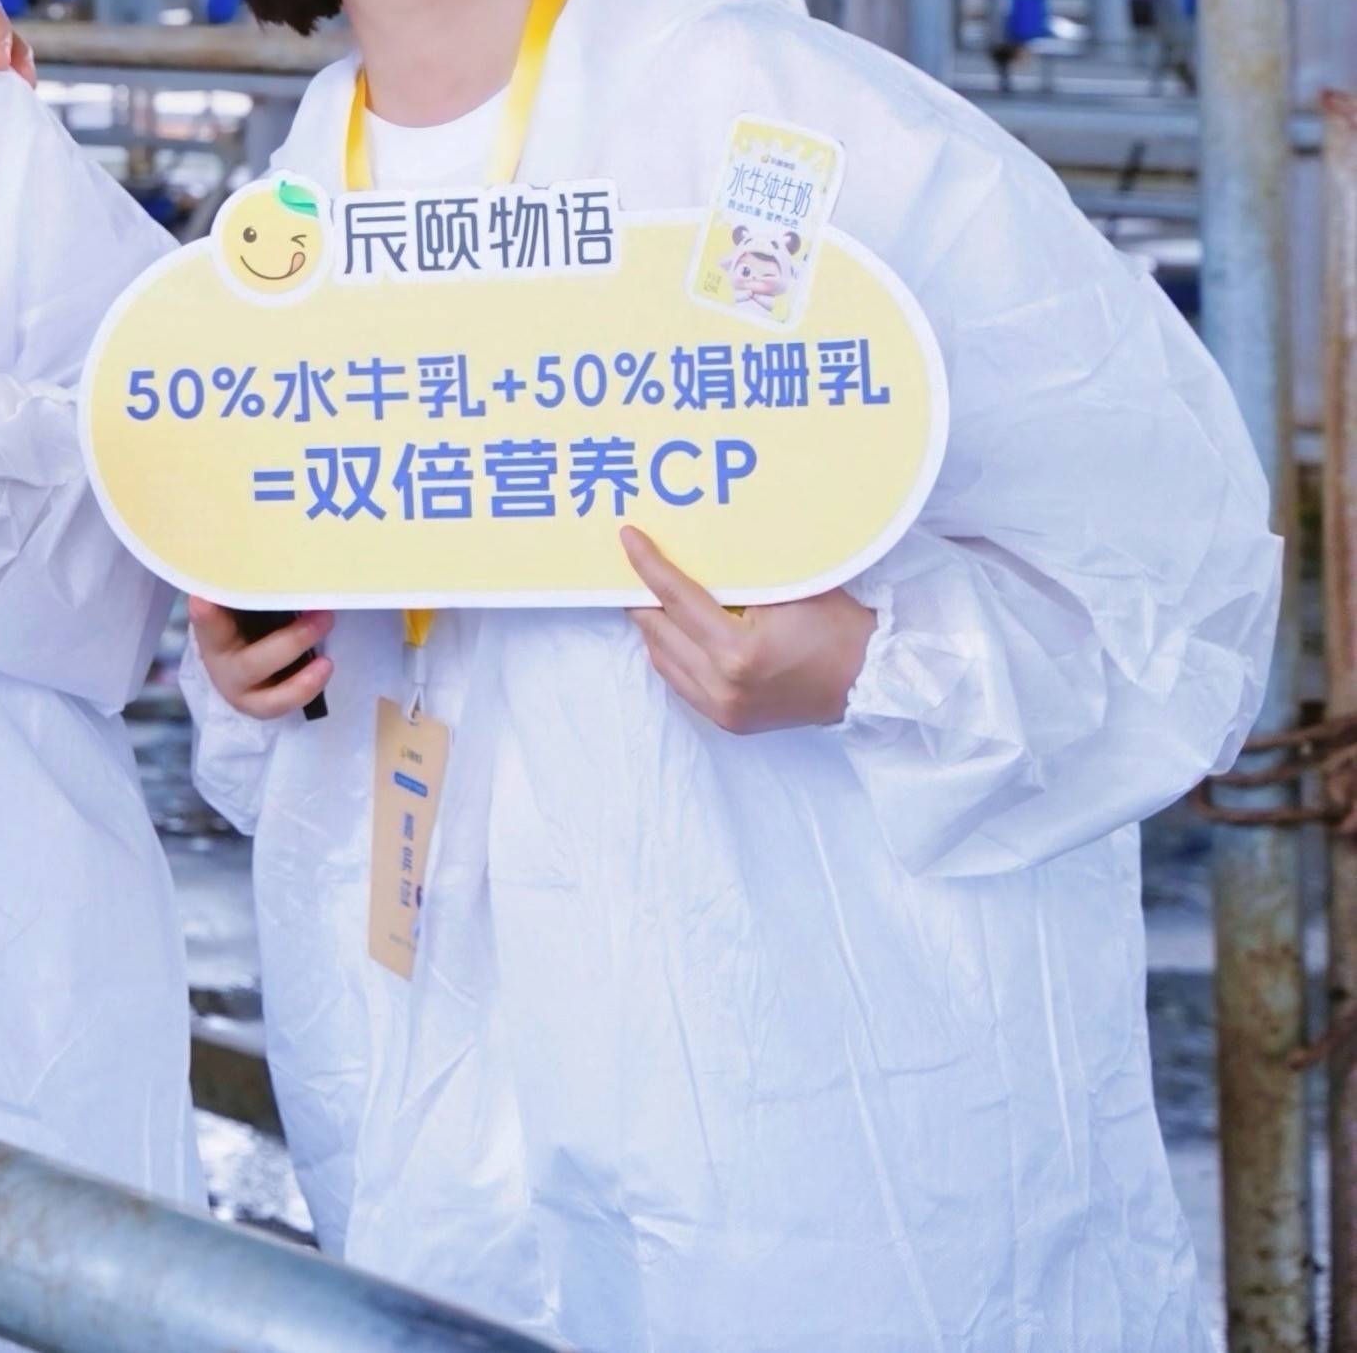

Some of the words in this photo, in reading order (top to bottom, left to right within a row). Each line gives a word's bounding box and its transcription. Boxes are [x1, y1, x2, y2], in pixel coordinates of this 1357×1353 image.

[727, 163, 814, 218] 水牛纯牛奶
[344, 191, 614, 275] 辰颐物语
[125, 338, 891, 423] 50%水牛乳+50%娟姗乳
[253, 435, 758, 522] =双倍营养CP
